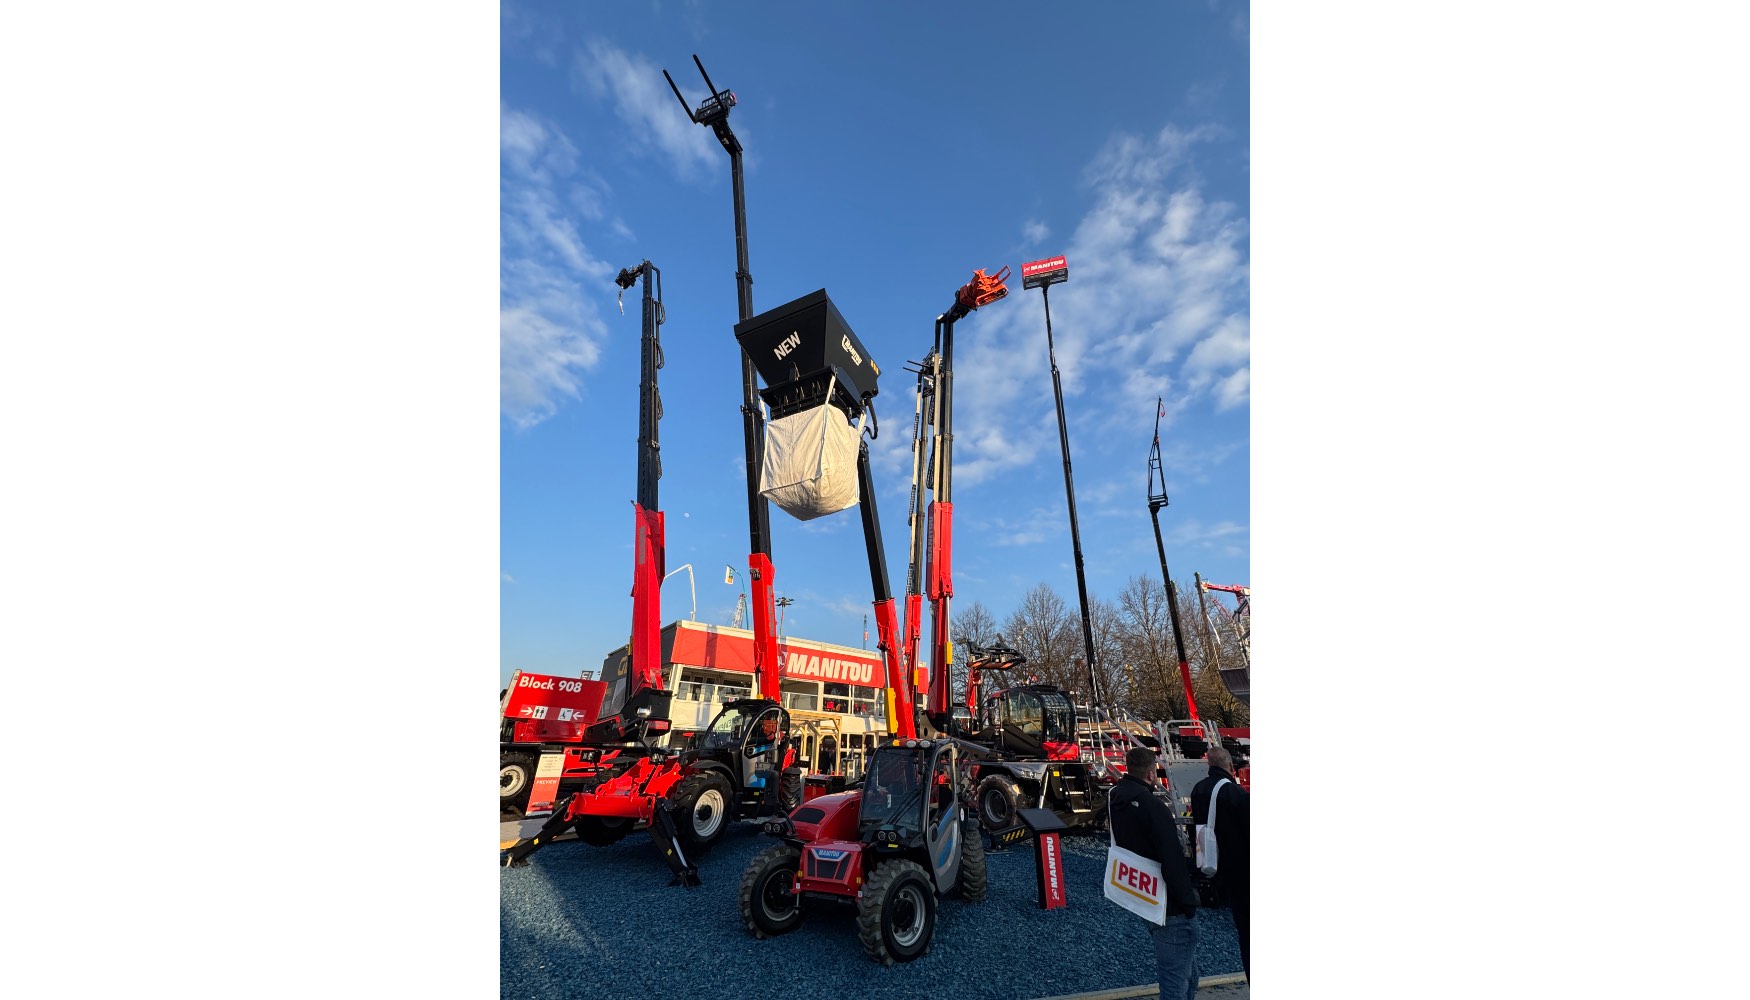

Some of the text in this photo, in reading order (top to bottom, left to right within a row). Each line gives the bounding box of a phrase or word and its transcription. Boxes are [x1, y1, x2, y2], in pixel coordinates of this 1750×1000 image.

[1030, 259, 1064, 271] MANITOU
[773, 330, 801, 361] NEW
[787, 652, 873, 683] MANITOU
[518, 675, 583, 693] Block 908
[818, 849, 840, 857] MANITOU
[1046, 836, 1058, 888] MANITOU
[1117, 861, 1158, 897] PERI
